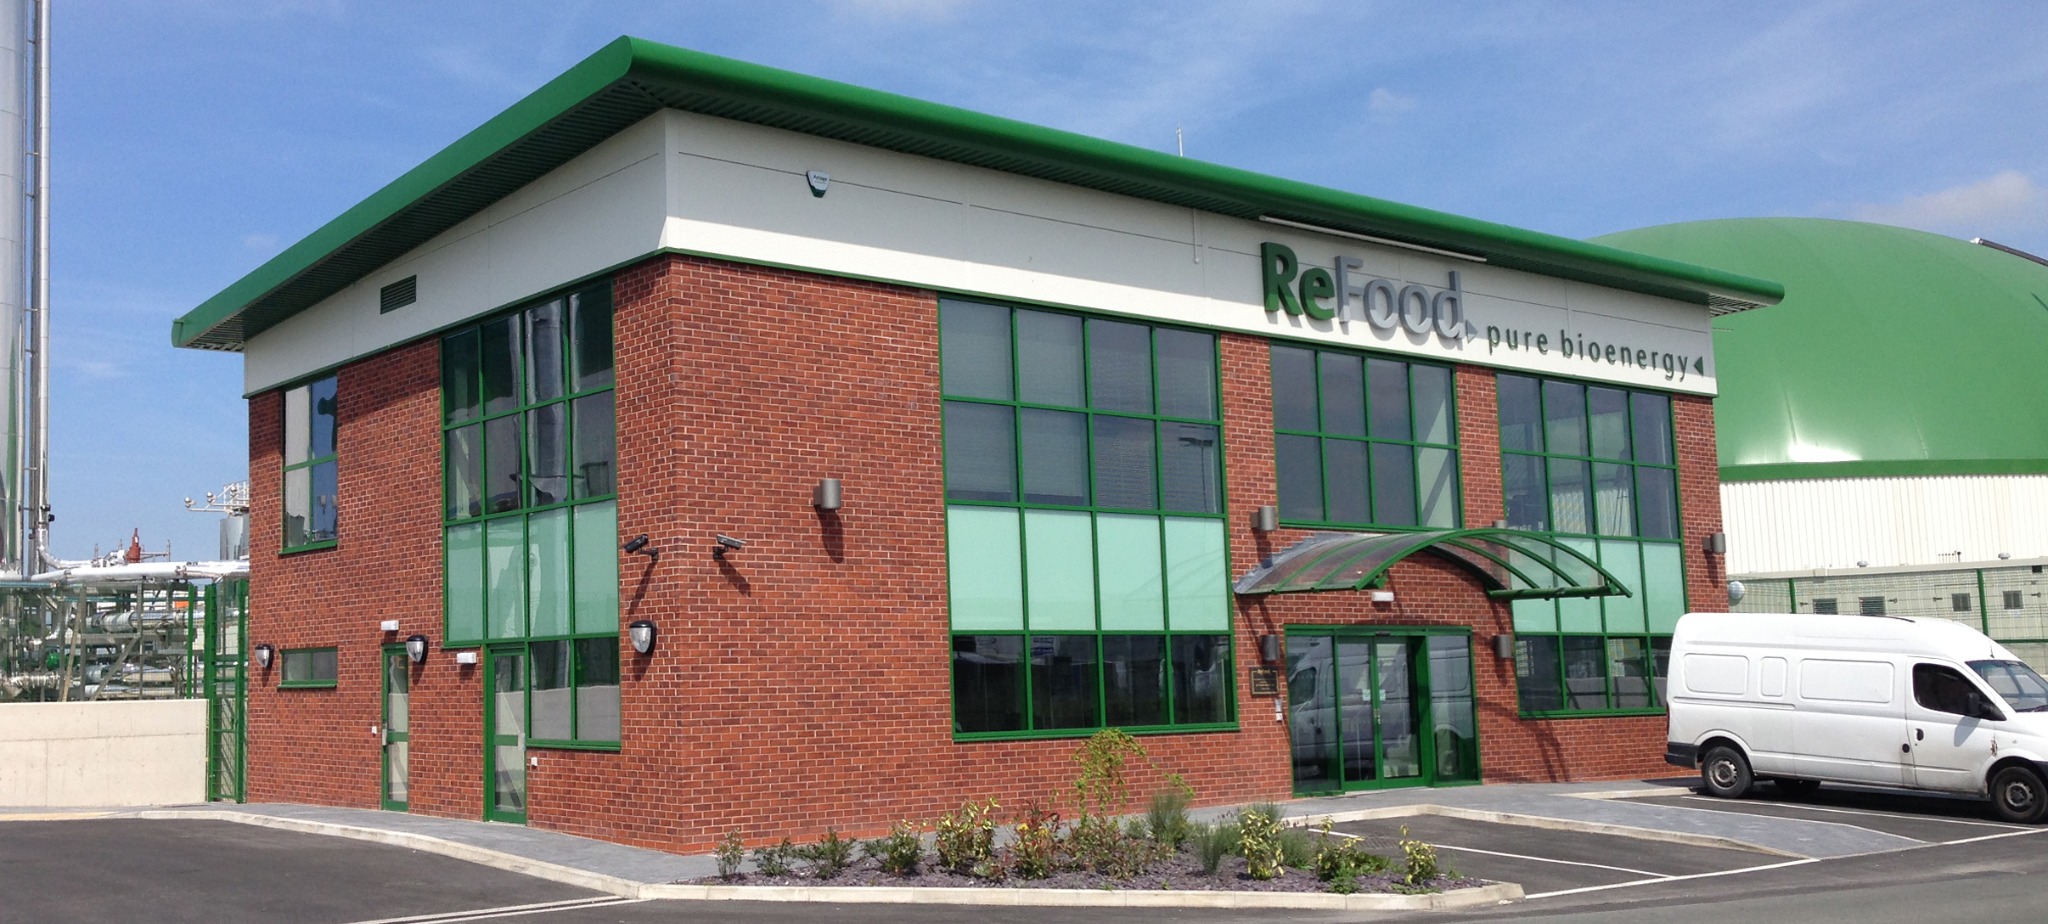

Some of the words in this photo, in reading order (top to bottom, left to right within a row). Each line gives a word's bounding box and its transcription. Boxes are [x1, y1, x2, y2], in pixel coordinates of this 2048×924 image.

[1261, 241, 1466, 340] ReFood
[1487, 325, 1549, 356] pure
[1561, 329, 1688, 382] bioenergy
